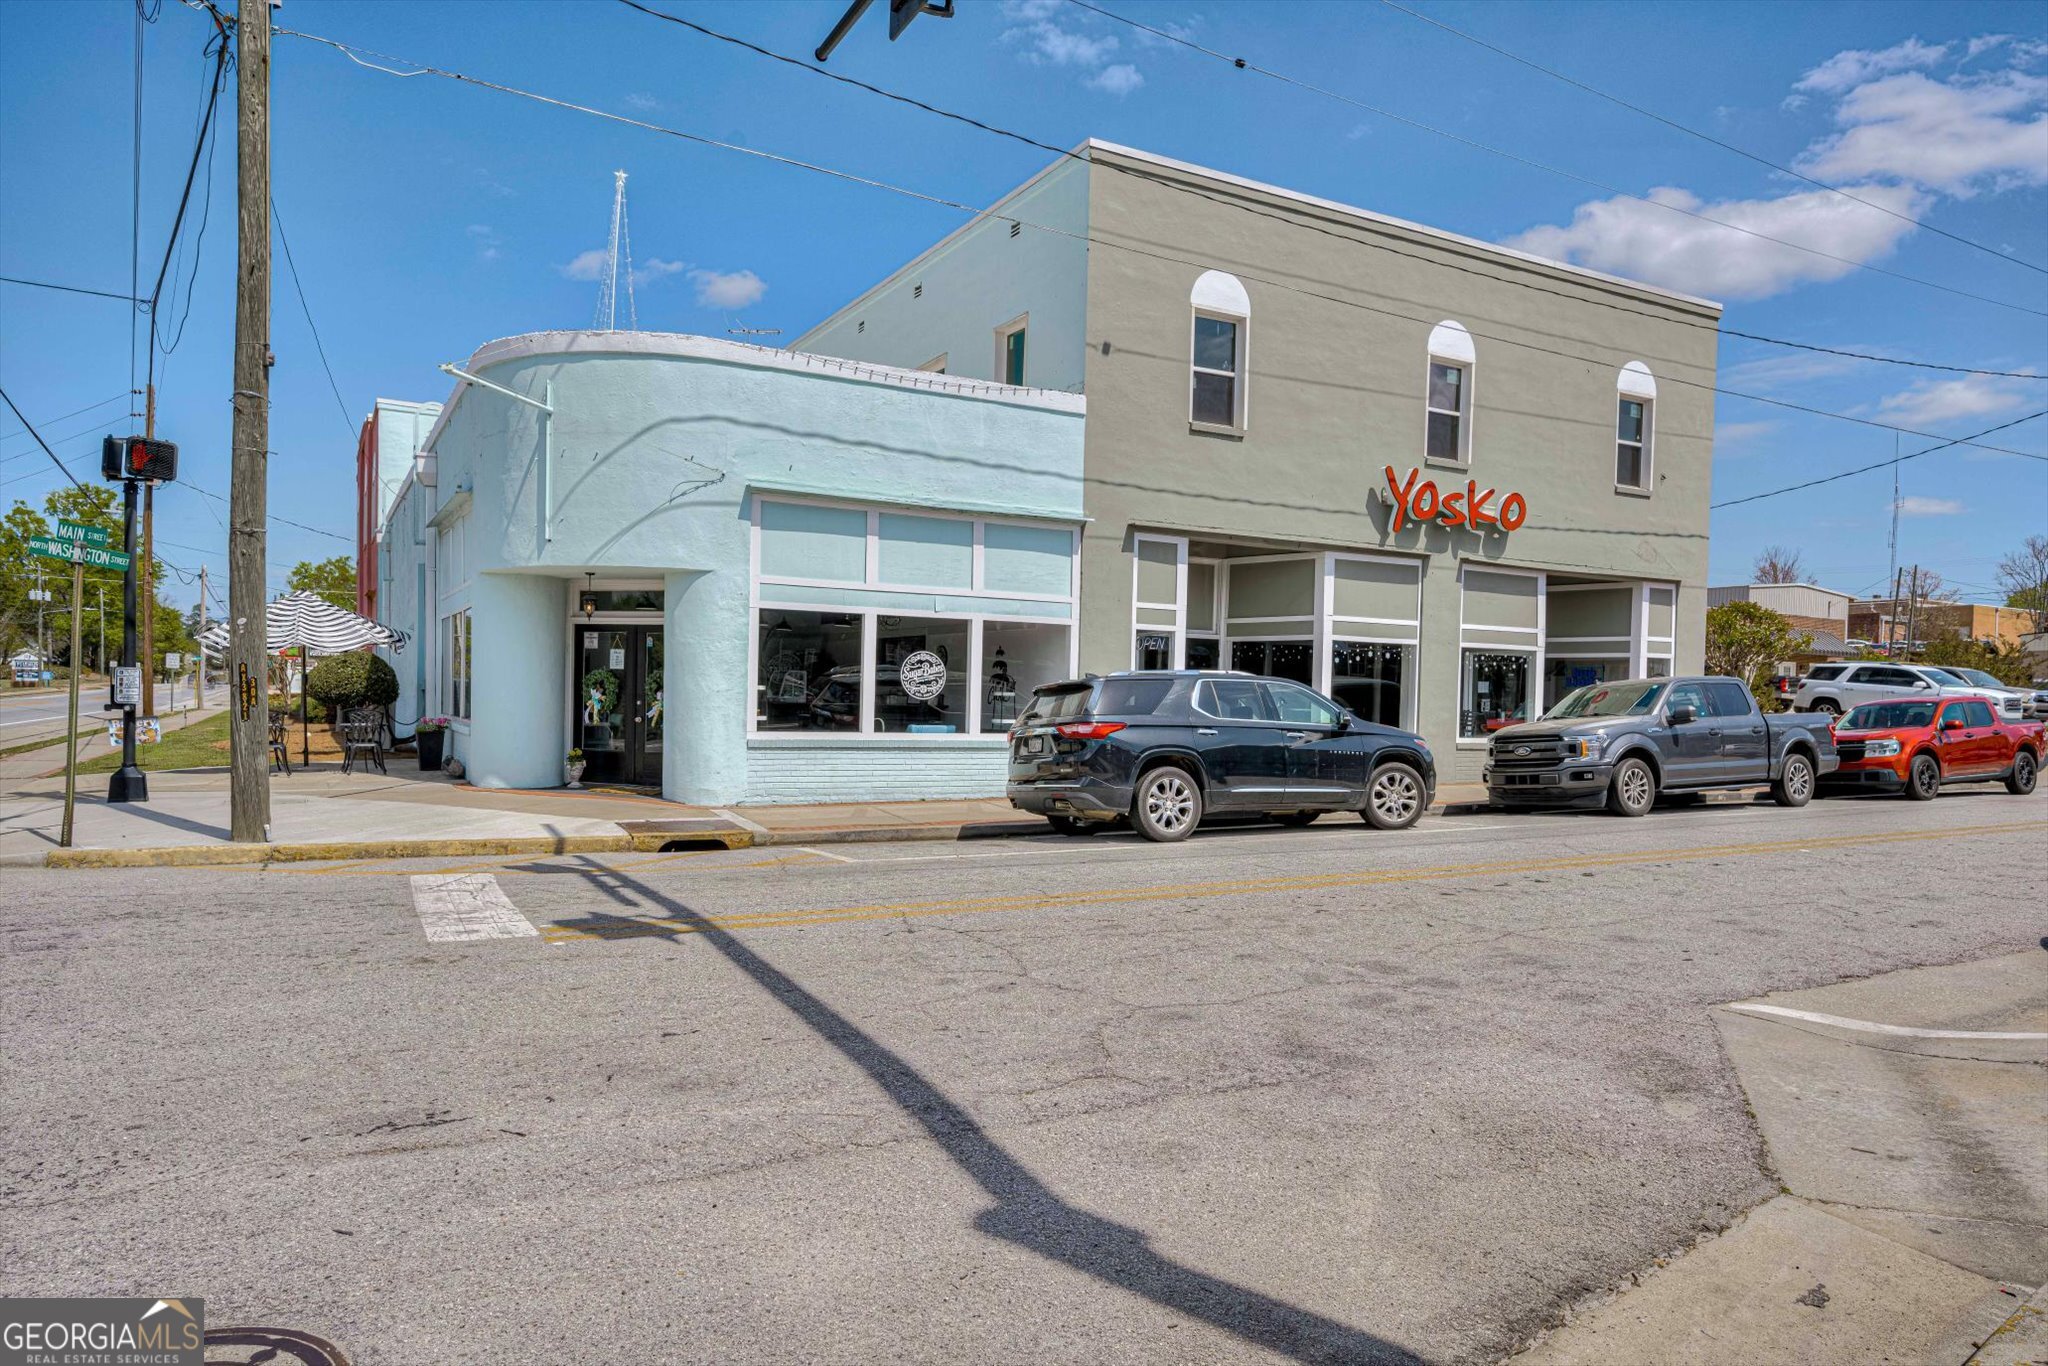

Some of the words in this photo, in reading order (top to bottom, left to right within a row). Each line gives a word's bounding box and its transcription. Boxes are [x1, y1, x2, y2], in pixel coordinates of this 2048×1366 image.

[58, 523, 86, 541] MAIN
[87, 531, 107, 542] STREET
[29, 539, 49, 551] NORTH
[48, 541, 111, 566] WASHNGTON
[110, 555, 130, 567] STREET
[1136, 636, 1166, 650] OPEN
